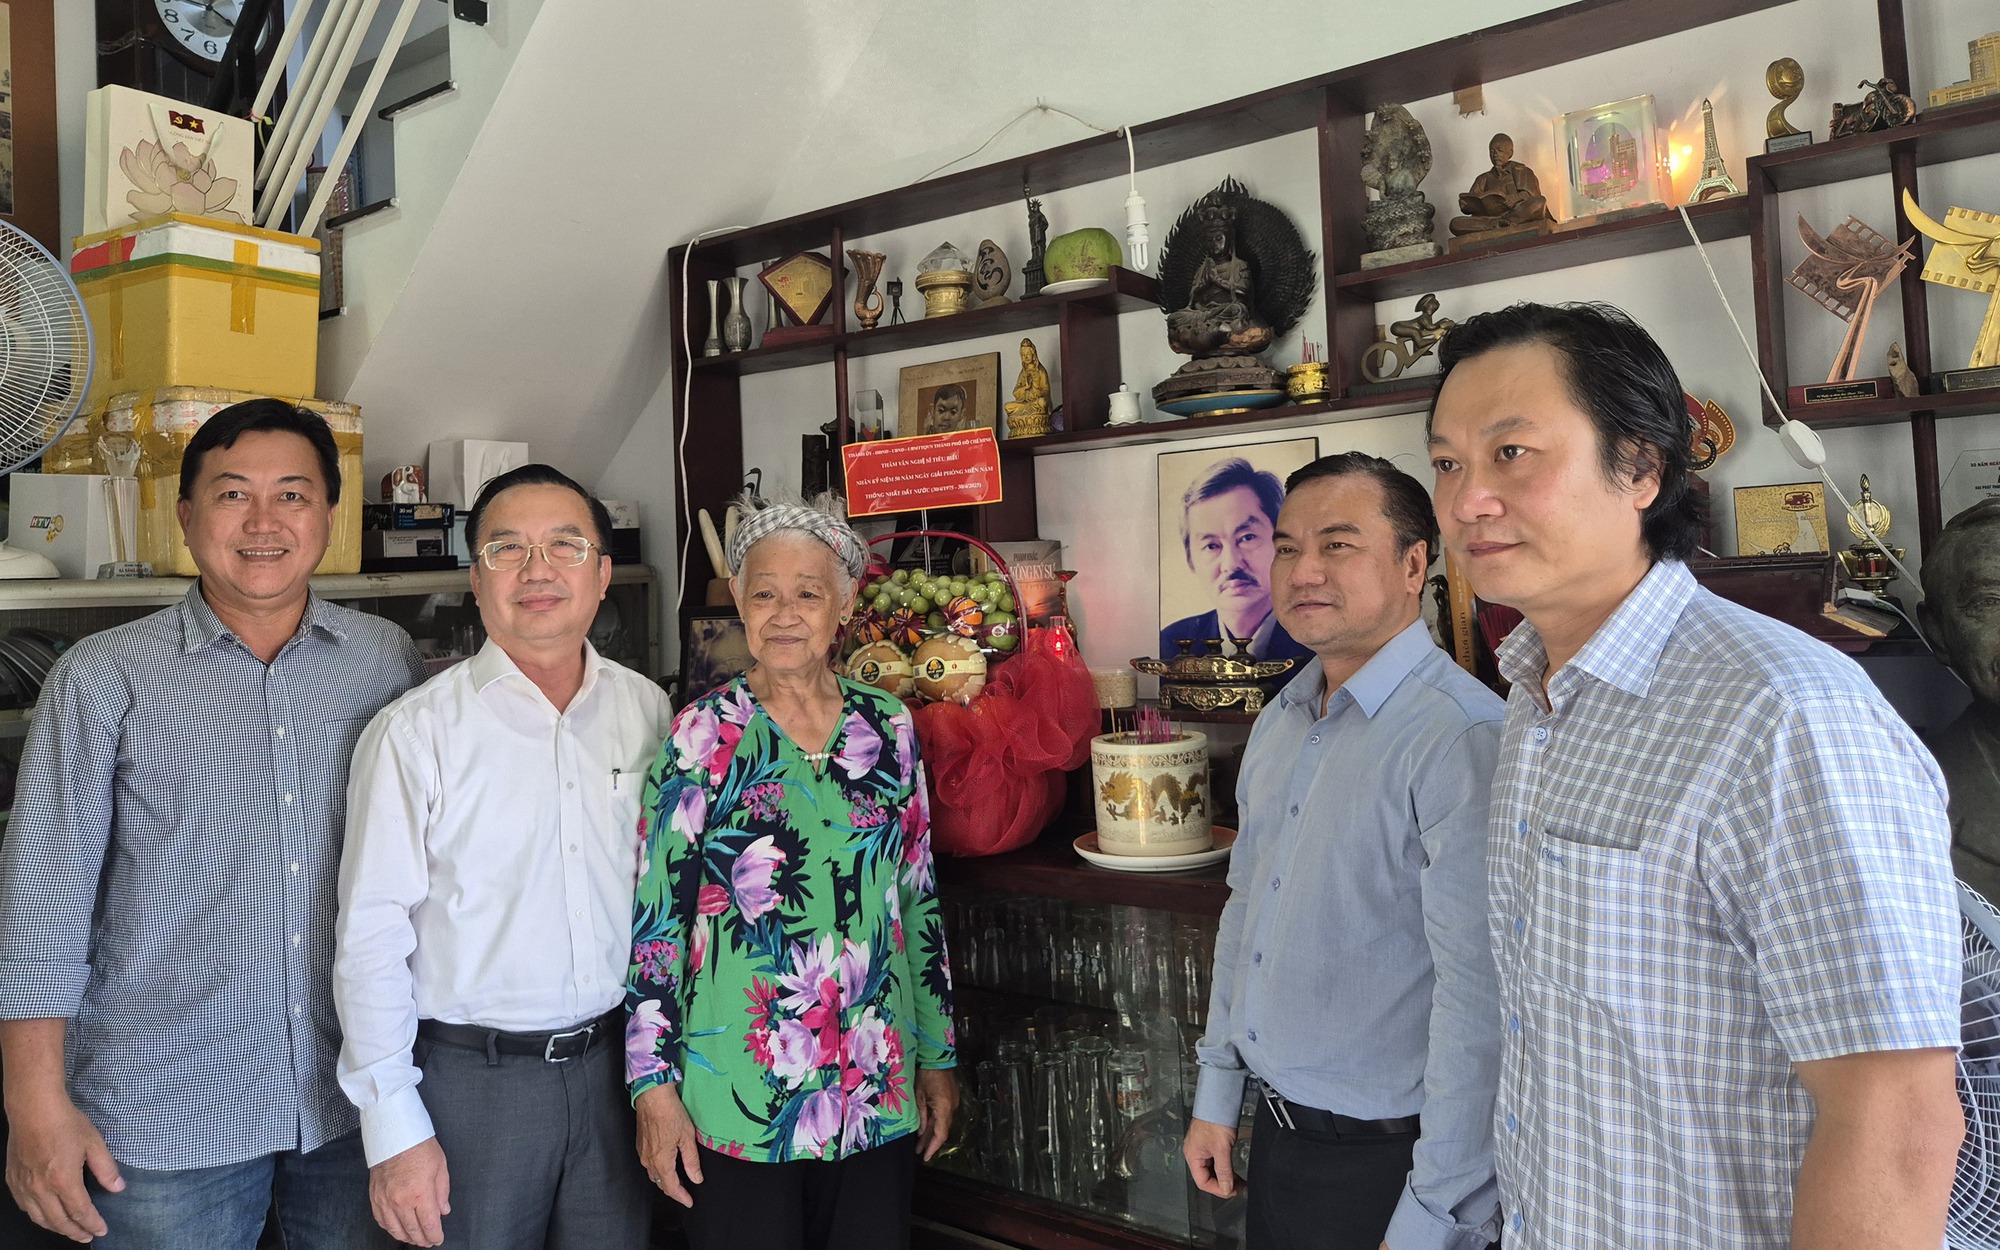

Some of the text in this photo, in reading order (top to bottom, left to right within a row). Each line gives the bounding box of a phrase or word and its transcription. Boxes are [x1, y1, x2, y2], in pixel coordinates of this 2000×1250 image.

[164, 9, 179, 23] 8
[181, 27, 195, 41] 7
[203, 40, 218, 54] 6
[865, 492, 884, 500] THỐNG
[885, 489, 900, 497] NHẤT
[30, 516, 51, 528] HTV
[1460, 612, 1470, 636] gian
